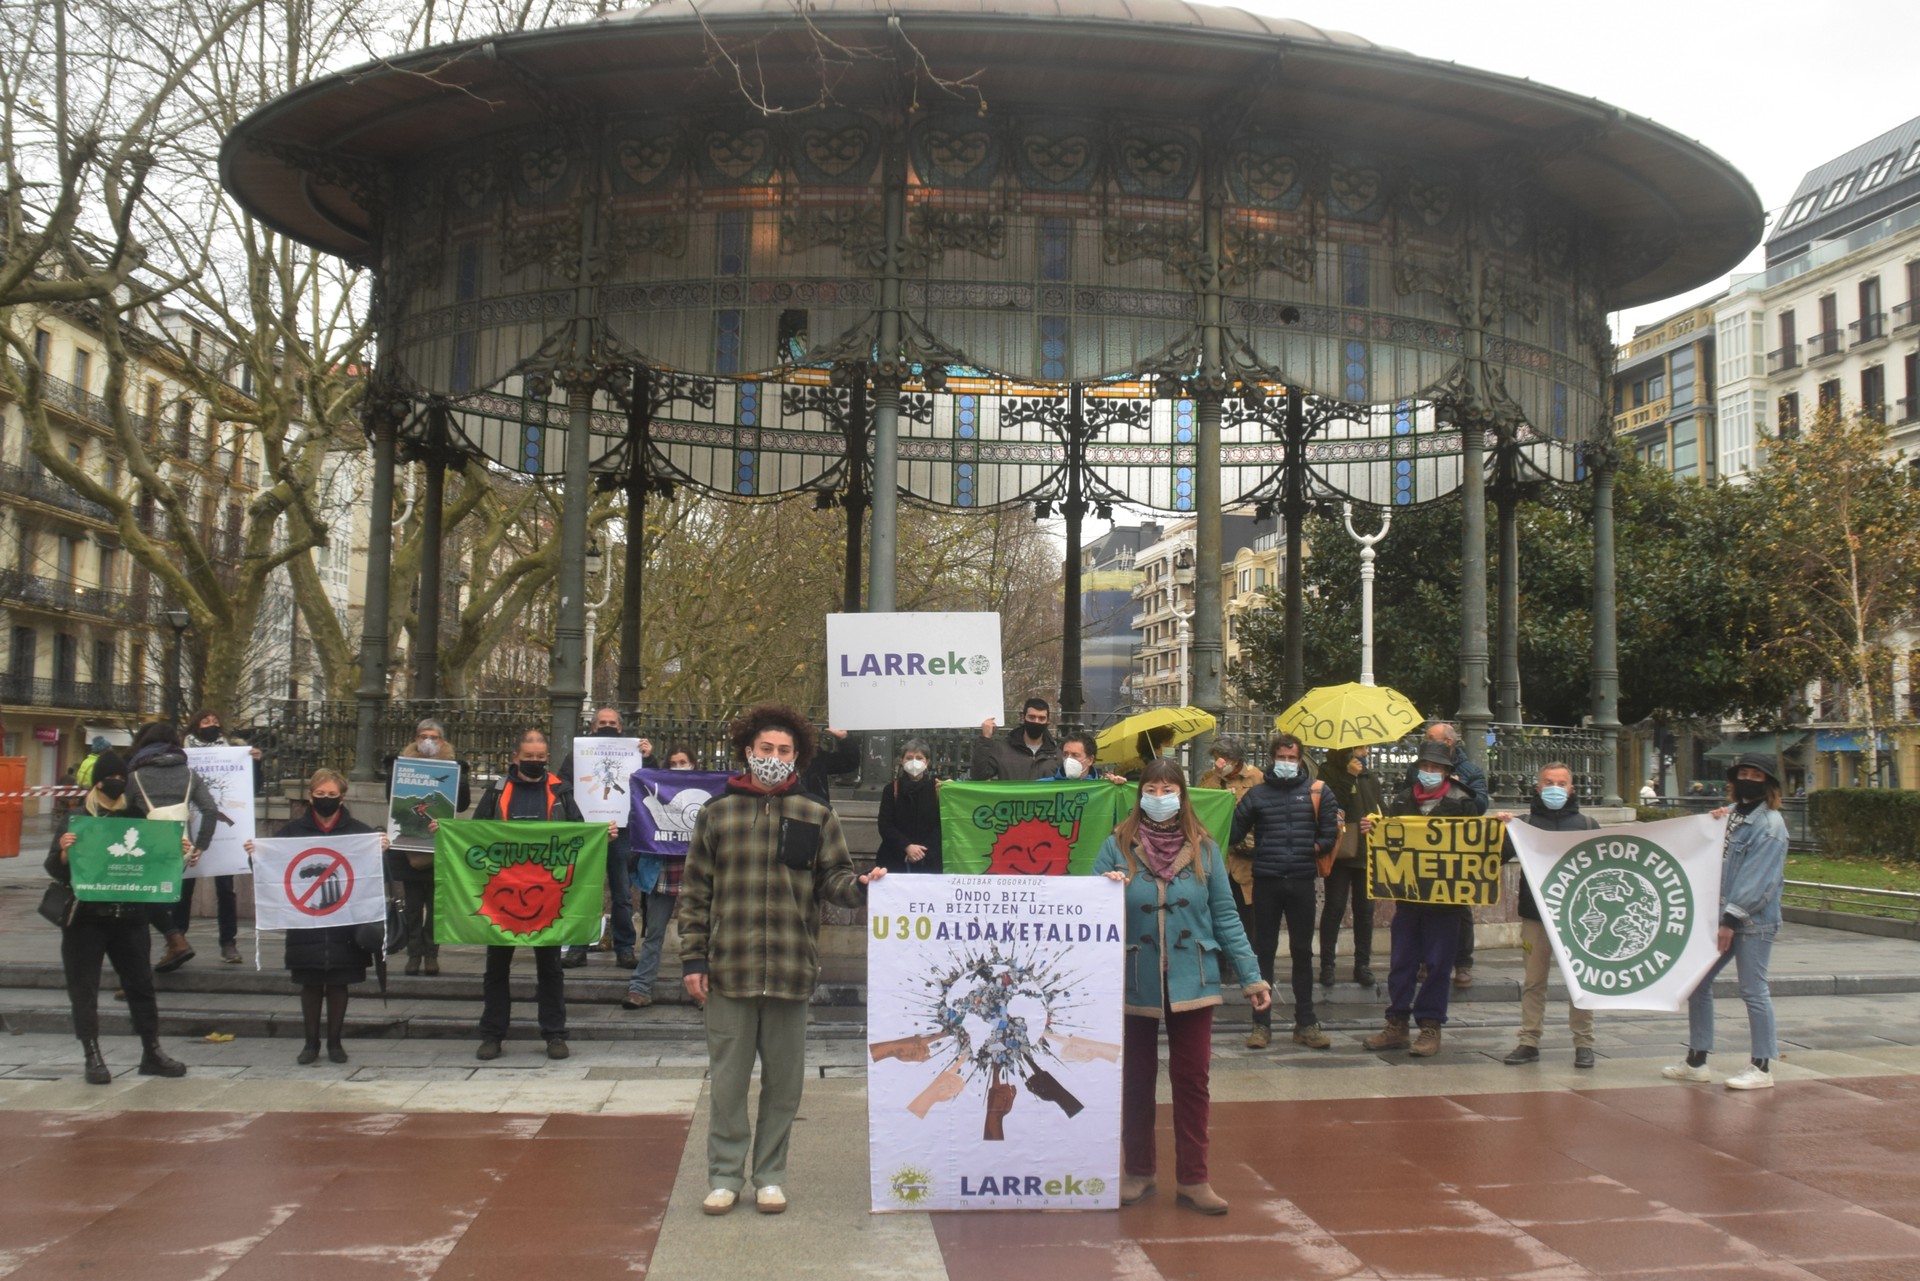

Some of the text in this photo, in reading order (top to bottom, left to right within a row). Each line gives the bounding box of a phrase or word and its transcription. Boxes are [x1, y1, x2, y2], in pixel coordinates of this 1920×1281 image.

[397, 778, 439, 787] ARALAR!
[973, 793, 1089, 833] eguzki
[1426, 818, 1503, 853] STOP
[465, 835, 584, 876] eguzki
[1376, 849, 1501, 893] METRO
[76, 882, 158, 894] www.haritzalde.org
[1002, 891, 1036, 903] BIZI
[1429, 879, 1490, 905] ARI
[1545, 841, 1687, 937] RIDAYS FOR FUTURE
[909, 902, 1084, 916] ETA BIZITZEN UZTEKO
